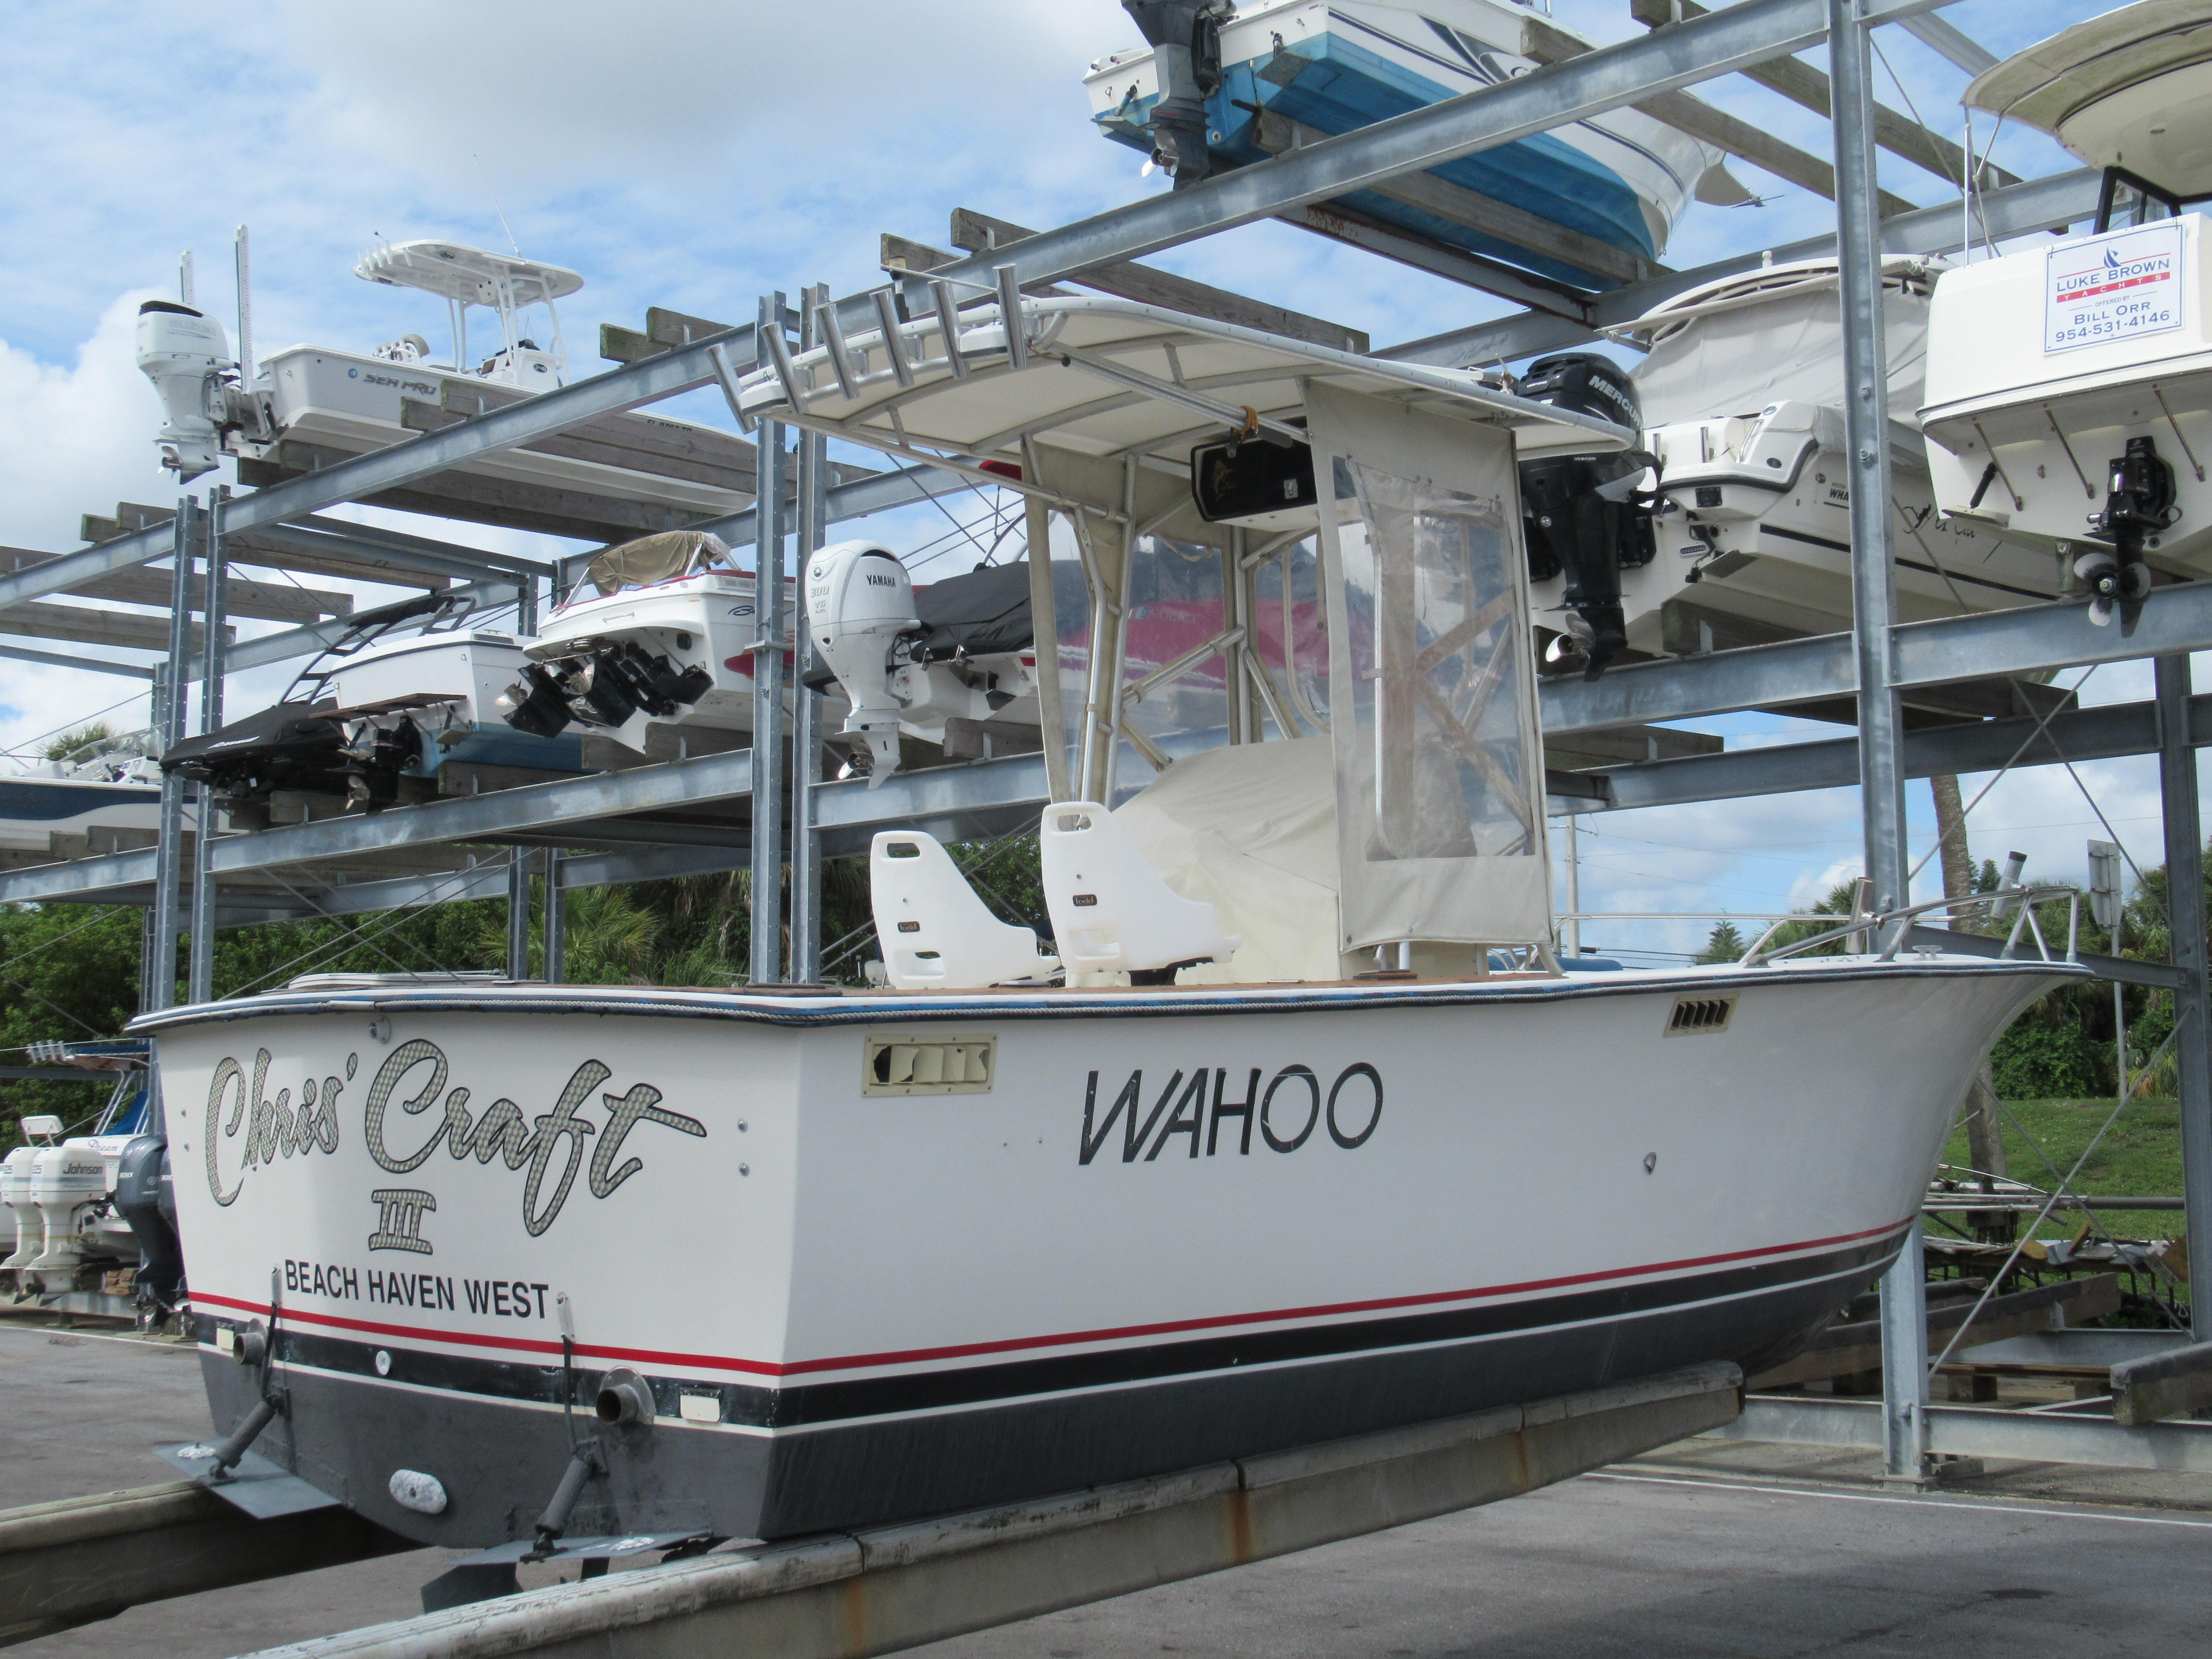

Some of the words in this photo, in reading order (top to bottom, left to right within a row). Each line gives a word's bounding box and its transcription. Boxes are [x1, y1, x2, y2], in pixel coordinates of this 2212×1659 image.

[2057, 273, 2100, 292] LUKE
[2108, 259, 2169, 280] BROWN
[2064, 274, 2162, 300] YACHTS
[2074, 311, 2110, 325] BILL
[2116, 302, 2151, 315] ORR
[2095, 297, 2122, 307] OFFERED
[2055, 310, 2170, 342] 954-531-4146
[363, 374, 399, 387] SEA
[401, 381, 437, 395] PRO
[1588, 375, 1642, 428] MERCUR
[1830, 488, 1849, 501] WHA
[811, 586, 830, 598] 300
[866, 575, 896, 588] YAMAHA
[1079, 1062, 1383, 1166] WAHOO
[88, 1139, 118, 1151] Dream
[365, 1039, 707, 1237] Craft
[63, 1161, 103, 1174] Johnson
[285, 1259, 359, 1301] BEACH
[368, 1269, 455, 1311] HAVEN
[464, 1279, 549, 1318] WEST
